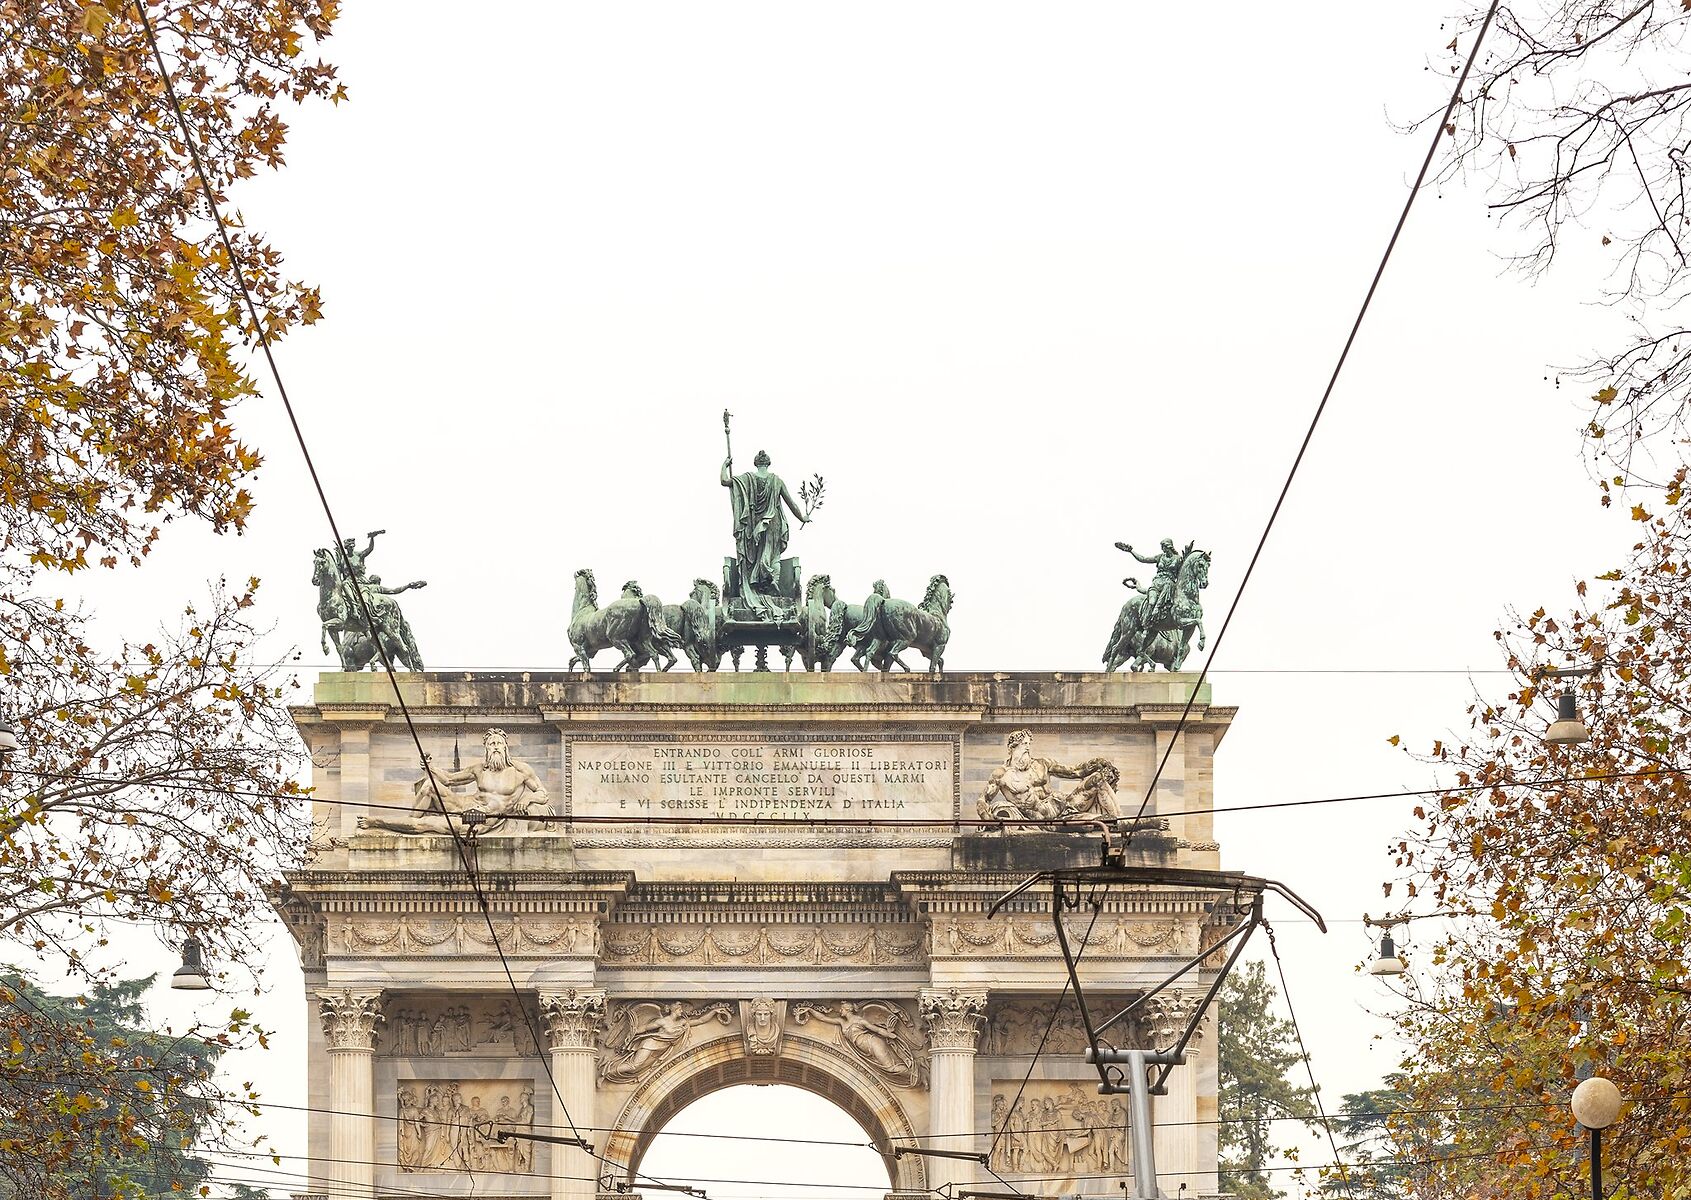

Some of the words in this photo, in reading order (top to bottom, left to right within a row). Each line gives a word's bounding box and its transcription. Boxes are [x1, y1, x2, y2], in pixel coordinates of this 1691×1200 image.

[654, 748, 721, 758] ENTRANDO
[773, 748, 804, 758] ARMI
[814, 748, 873, 758] GLORIOSE
[578, 761, 652, 771] NAPOLEONE
[663, 761, 675, 771] III
[686, 761, 693, 771] E
[703, 761, 764, 771] VITTORIO
[773, 761, 841, 771] EMANUELE
[851, 761, 860, 771] II
[870, 761, 947, 771] LIBERATORI
[600, 774, 650, 783] MILANO
[660, 774, 727, 783] ESULTANTE
[807, 774, 824, 783] DA
[832, 774, 876, 784] QUESTI
[884, 774, 925, 783] MARMI
[690, 787, 703, 796] LE
[713, 787, 778, 796] IMPRONTE
[788, 787, 836, 796] SERVILI
[620, 800, 626, 809] E
[638, 800, 650, 809] VI
[661, 800, 709, 809] SCRISSE
[735, 800, 832, 809] INDIPENDENZA
[862, 800, 905, 809] ITALIA
